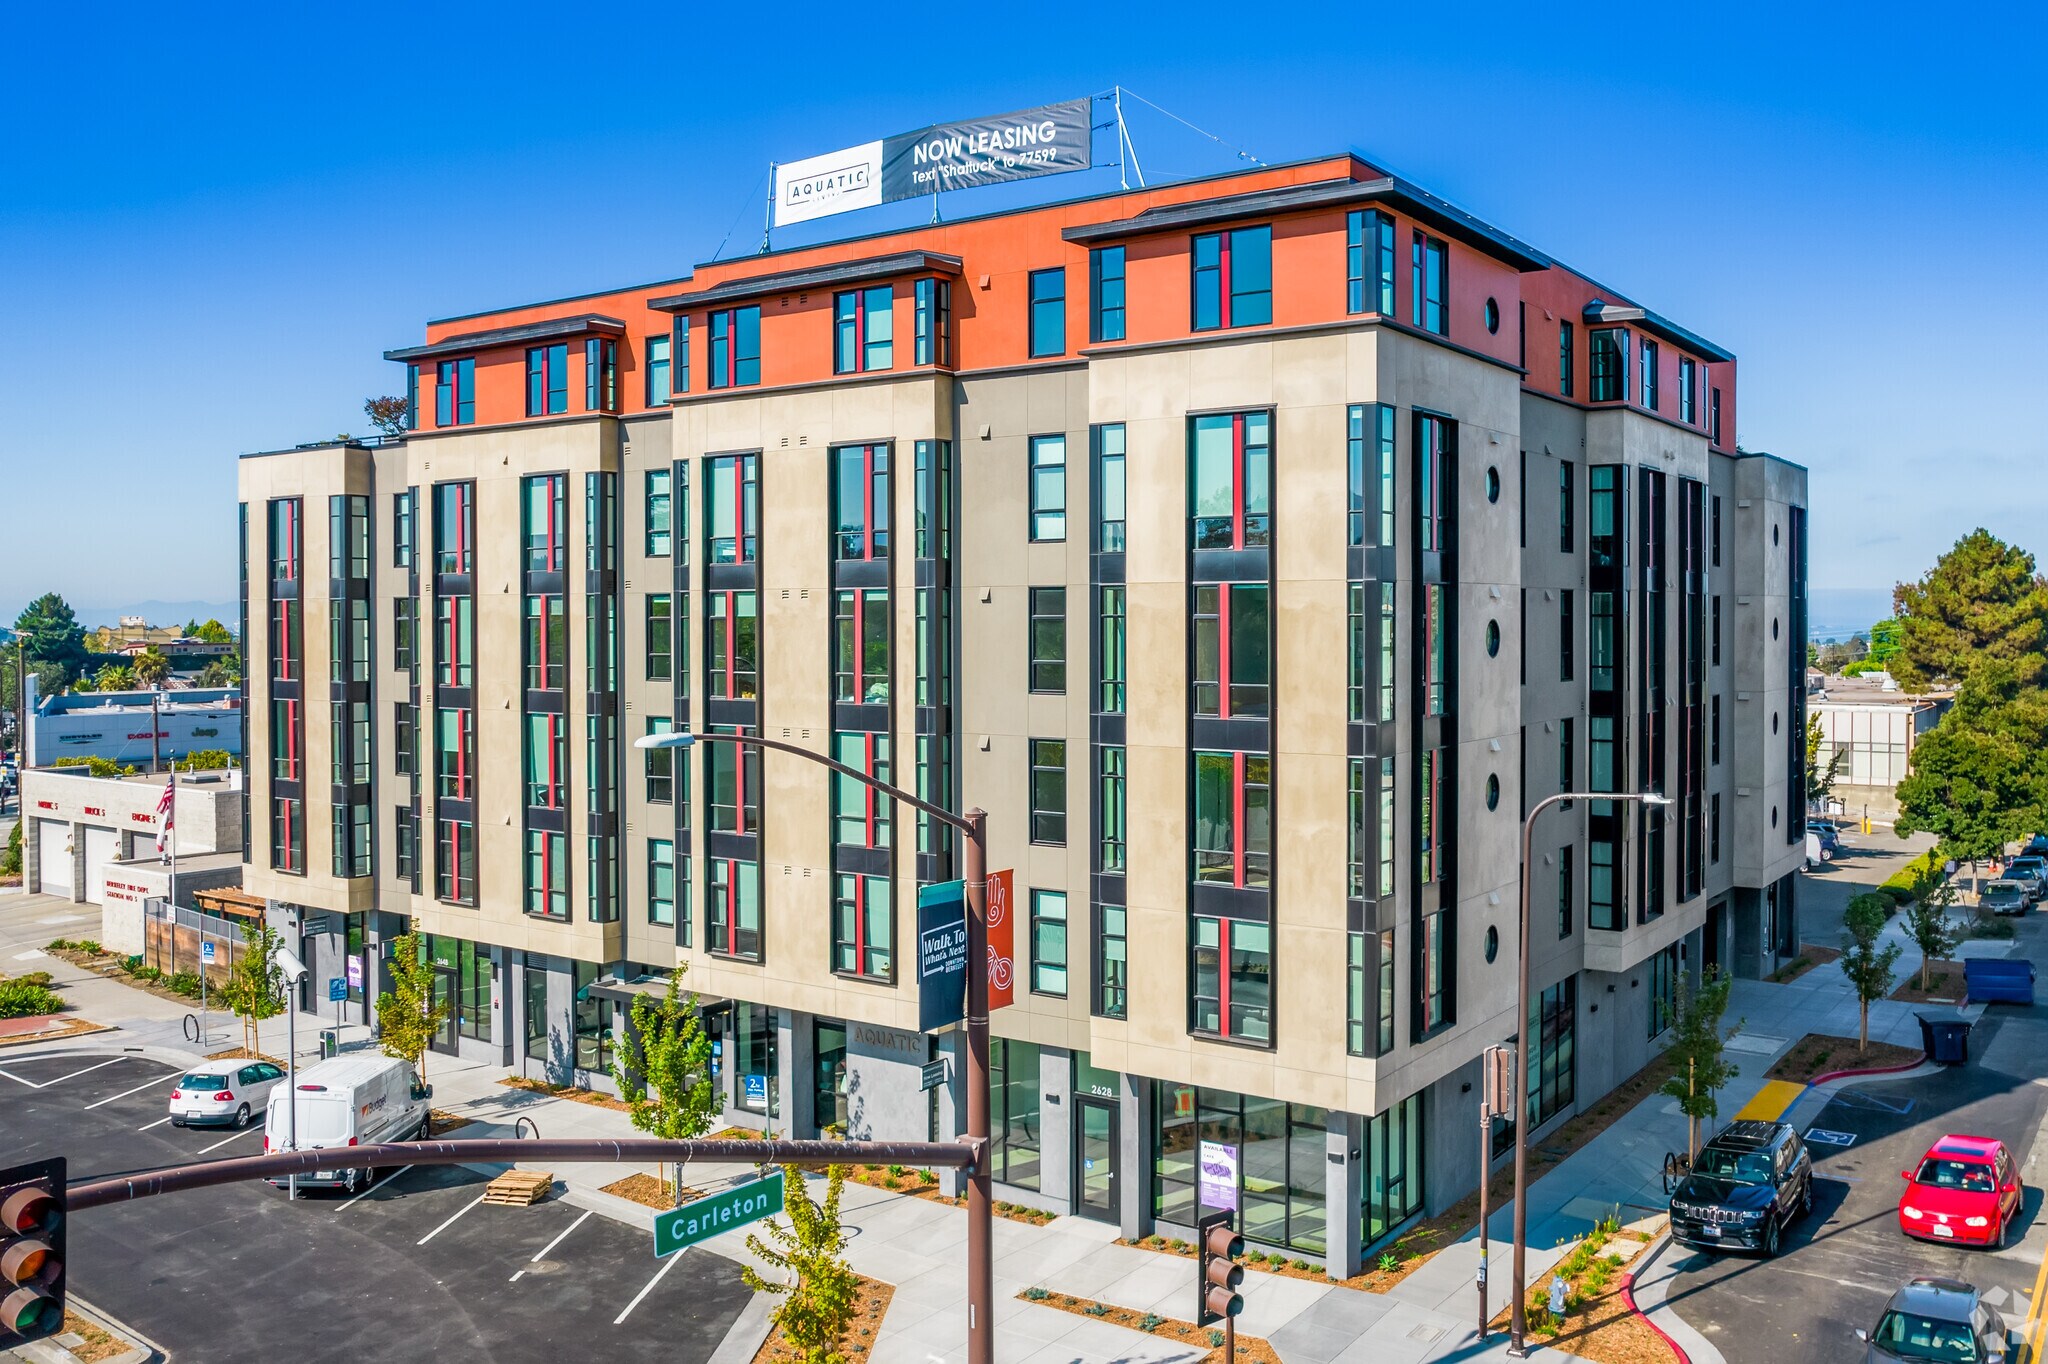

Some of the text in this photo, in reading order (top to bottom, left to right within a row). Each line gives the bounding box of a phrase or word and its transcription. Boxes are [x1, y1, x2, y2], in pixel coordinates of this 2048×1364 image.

[913, 120, 1056, 165] NOW LEASING
[912, 147, 1057, 184] Text "Shattuck" to 77599
[792, 171, 864, 198] AQUATIC
[191, 727, 218, 738] Jeep
[925, 929, 965, 955] Walk To
[925, 944, 966, 966] What's Next
[945, 956, 964, 967] DOWNTOWN
[855, 1026, 920, 1053] AQUATIC
[1091, 1084, 1112, 1097] 2628
[369, 1093, 387, 1114] Budget
[1203, 1144, 1233, 1155] AVAILABLE
[671, 1193, 767, 1240] Carleton
